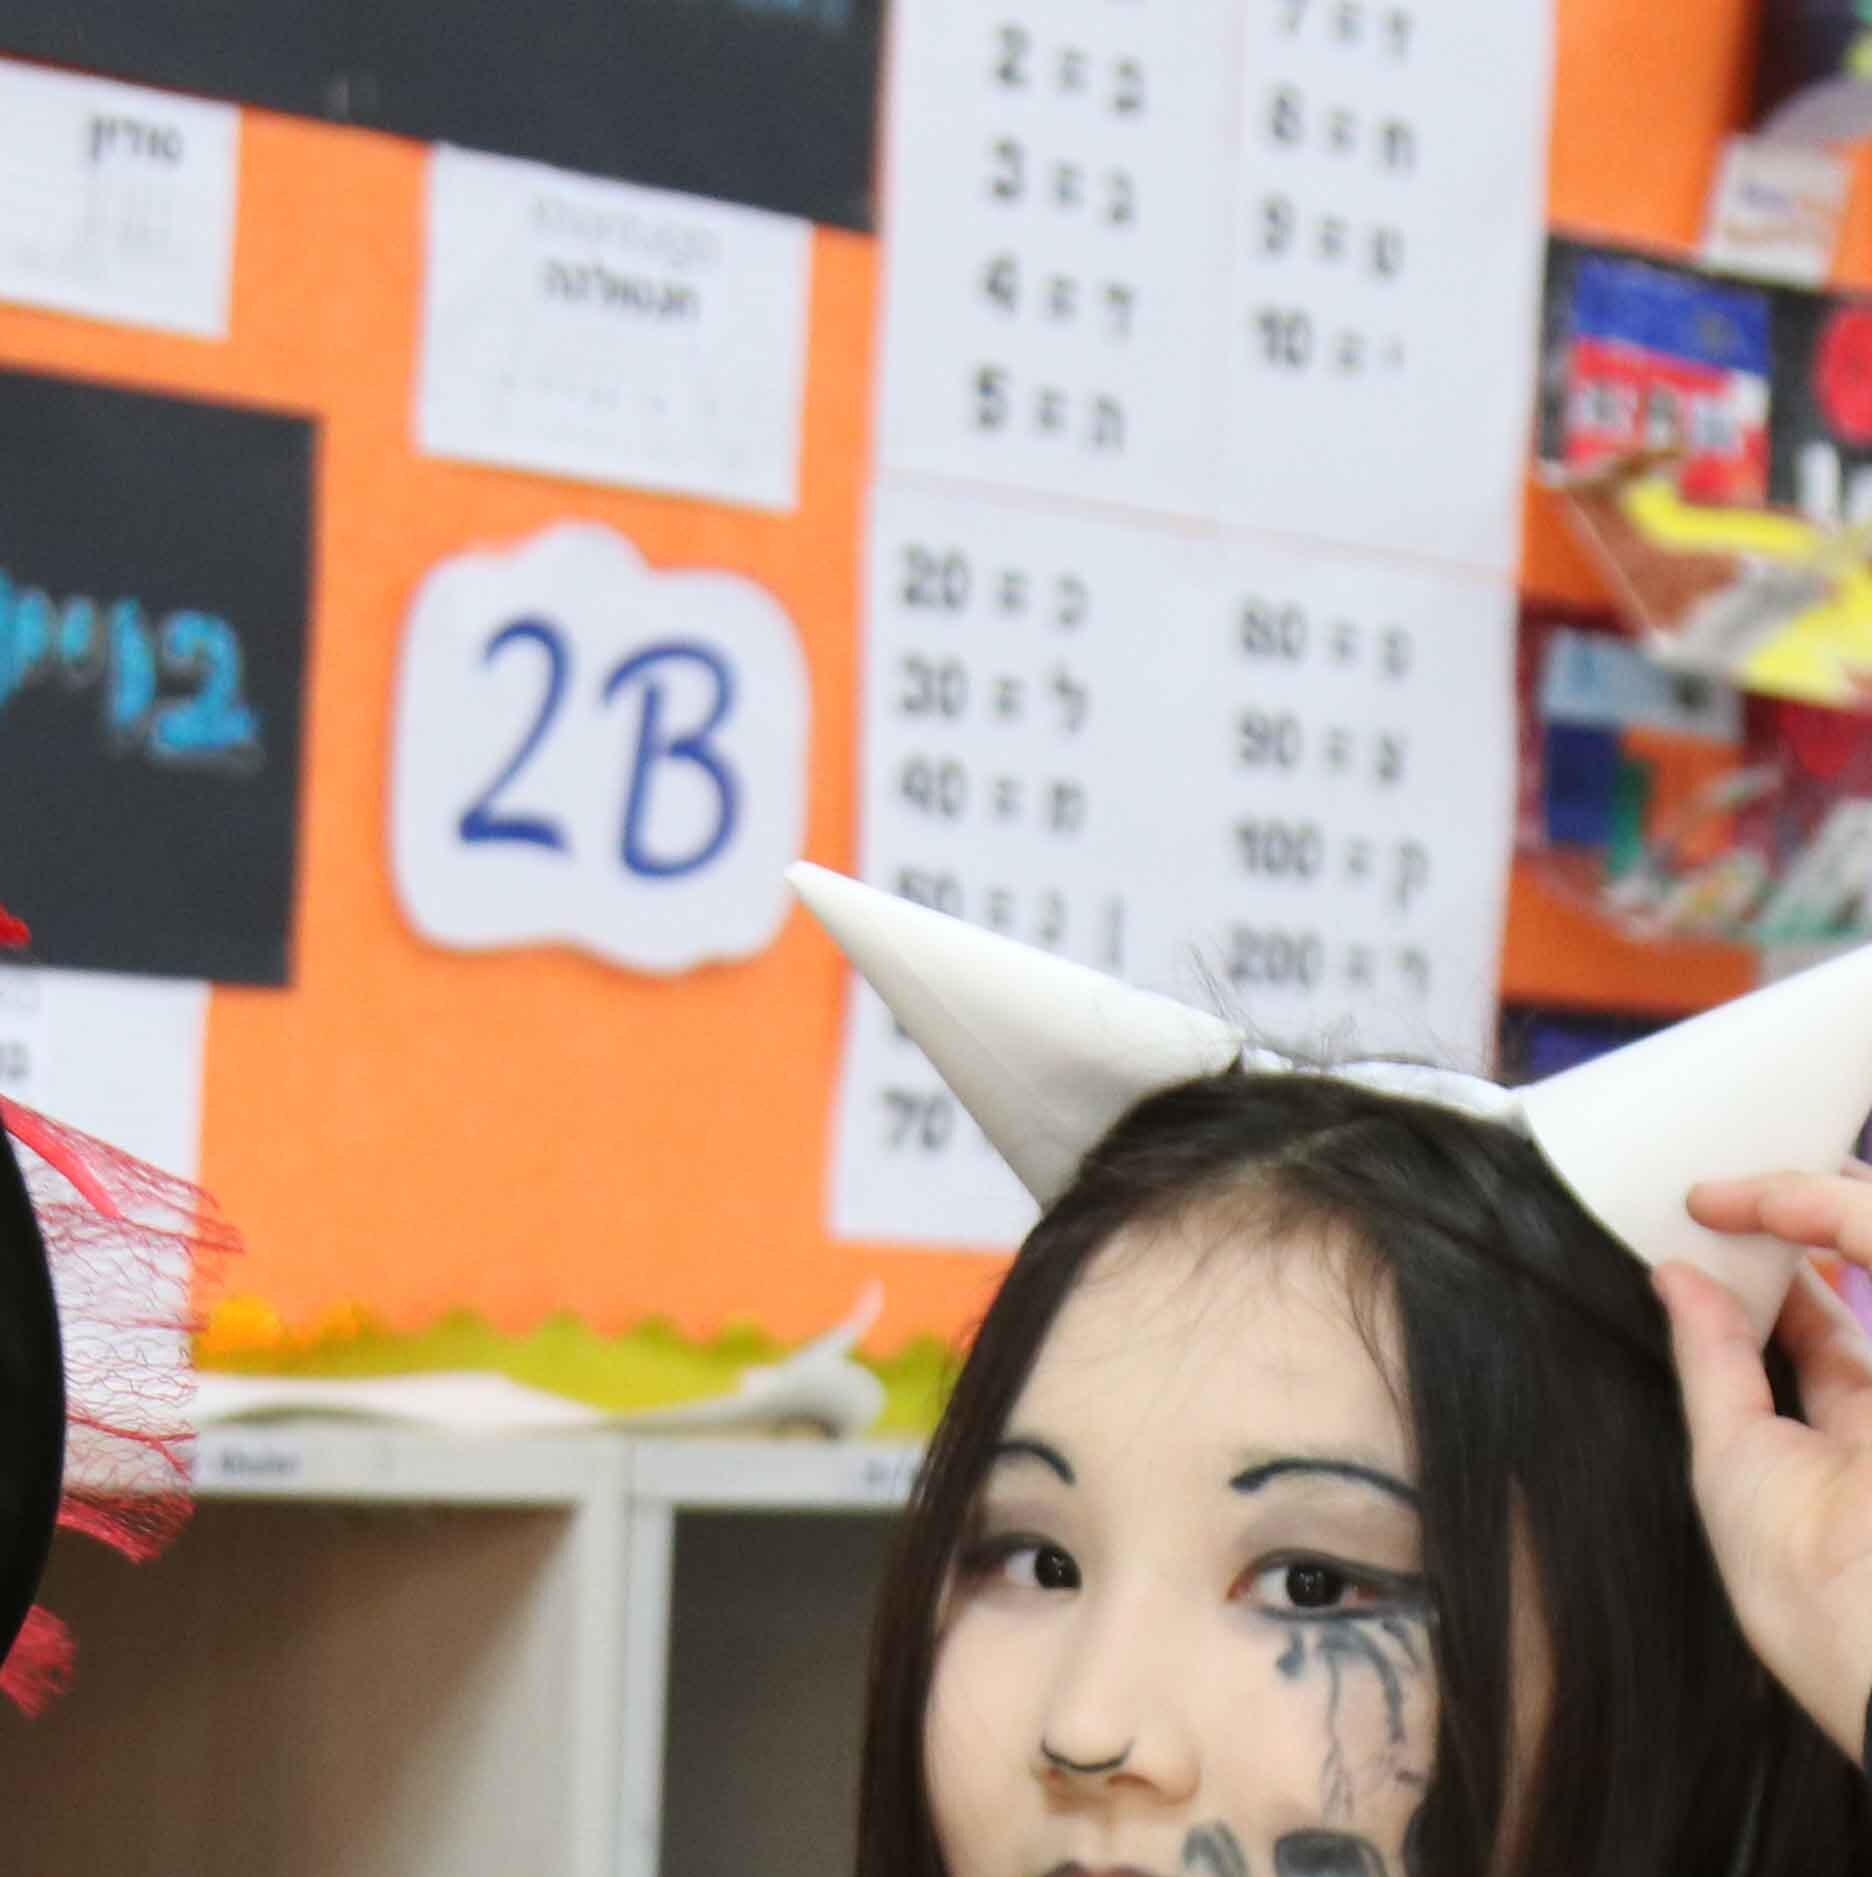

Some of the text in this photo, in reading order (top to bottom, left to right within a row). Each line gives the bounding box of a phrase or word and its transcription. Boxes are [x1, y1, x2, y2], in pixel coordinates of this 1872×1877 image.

[991, 24, 1030, 90] 2
[989, 136, 1025, 206] 3
[978, 254, 1020, 314] 4
[1252, 305, 1314, 371] 10
[970, 363, 1008, 434] 5
[898, 544, 971, 615] 20
[897, 652, 968, 722] 30
[455, 613, 743, 883] 2B
[895, 755, 967, 822] 40
[1231, 818, 1325, 883] 100
[882, 1092, 958, 1153] 70
